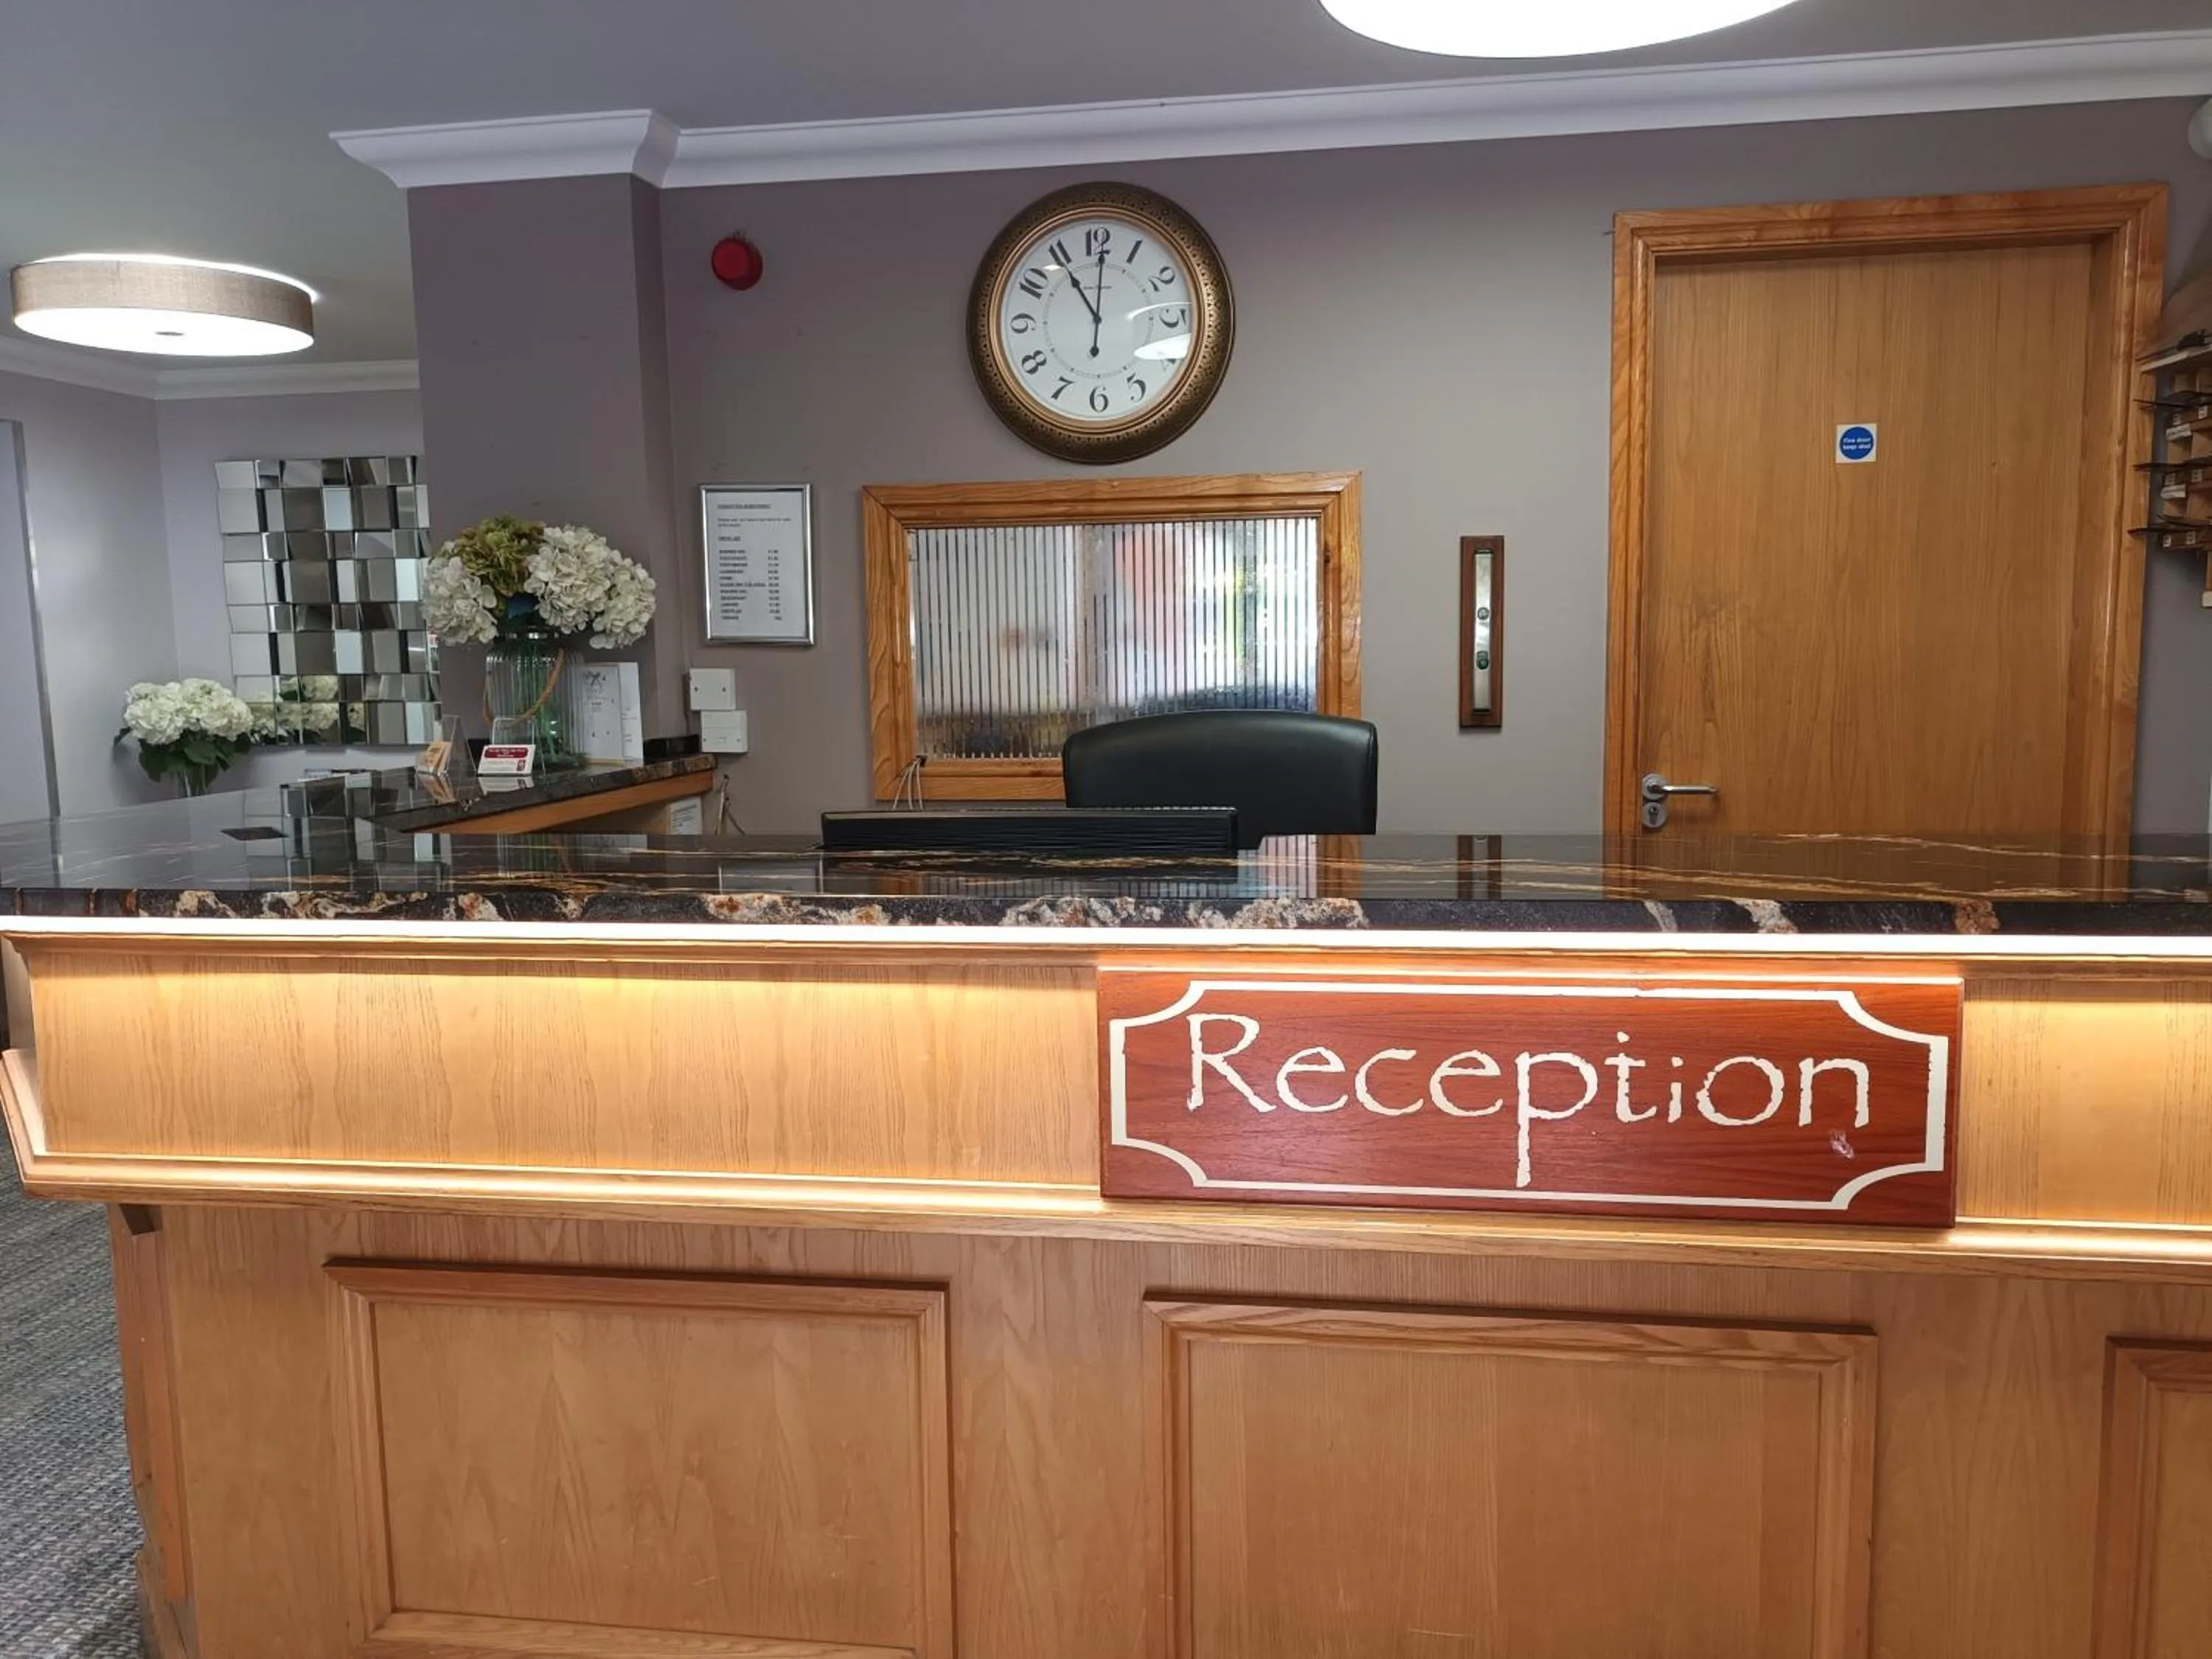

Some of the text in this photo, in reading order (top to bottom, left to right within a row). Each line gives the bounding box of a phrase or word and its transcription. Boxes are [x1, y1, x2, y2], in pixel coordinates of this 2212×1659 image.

[1048, 240, 1072, 266] 11
[1085, 226, 1110, 256] 12
[1126, 240, 1142, 264] 1
[1019, 268, 1048, 299] 10
[1147, 266, 1175, 292] 2
[1009, 313, 1035, 333] 9
[1159, 308, 1186, 328] 3
[1021, 350, 1047, 375] 8
[1050, 377, 1074, 400] 7
[1089, 386, 1109, 412] 6
[1127, 374, 1146, 402] 5
[1186, 1012, 1871, 1189] Reception
